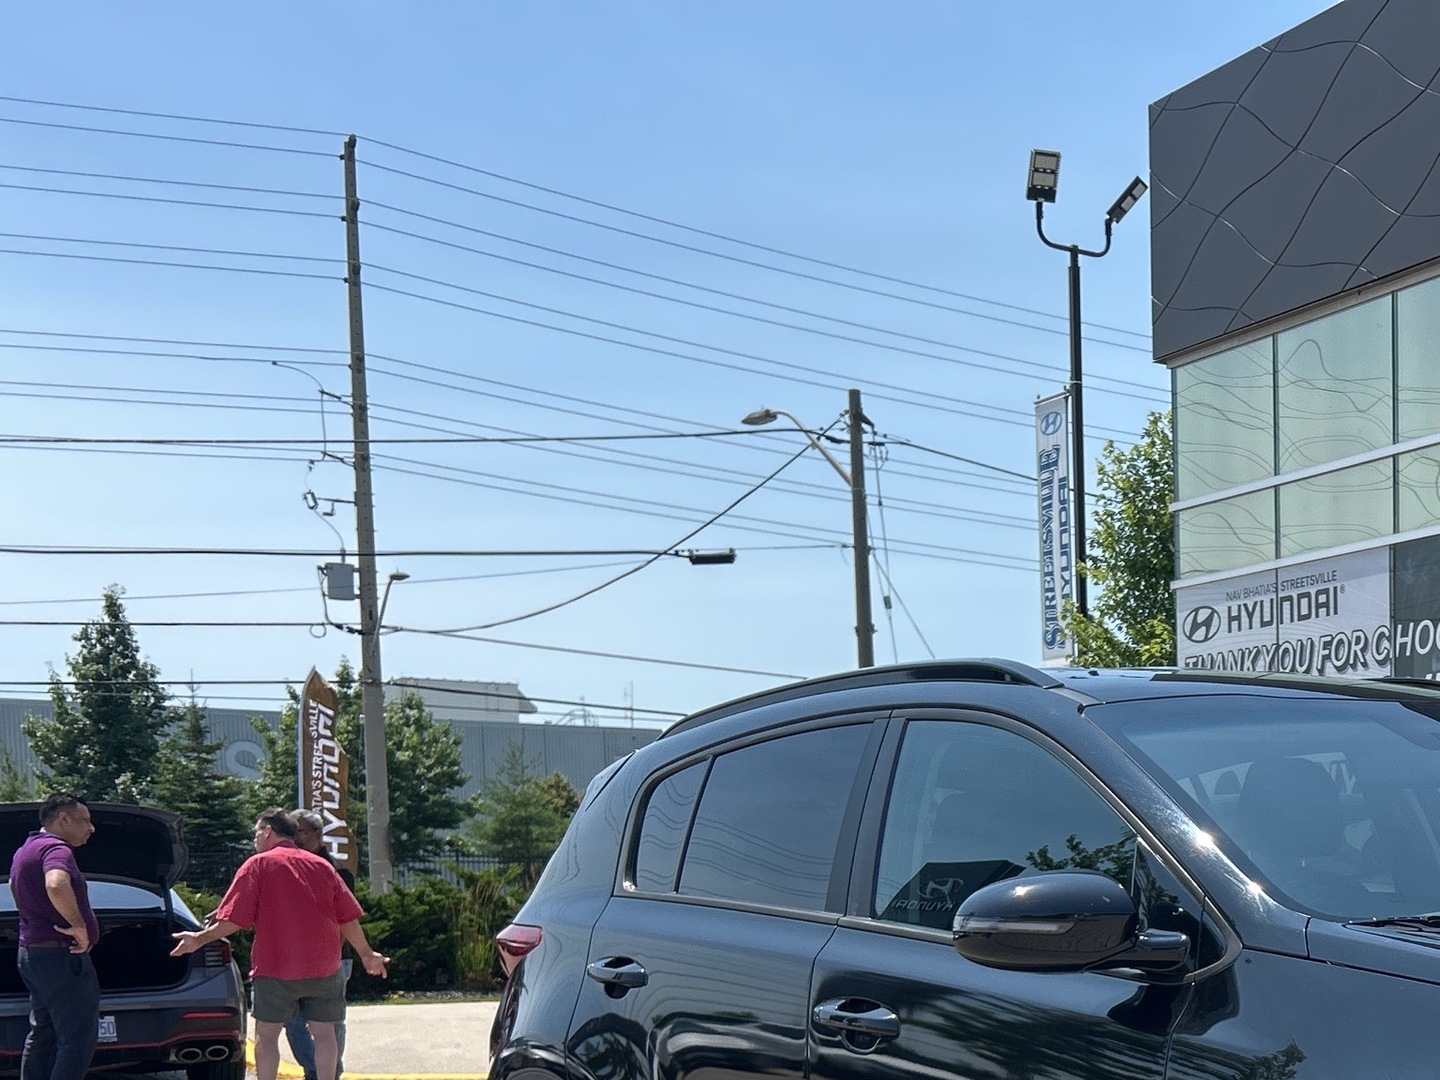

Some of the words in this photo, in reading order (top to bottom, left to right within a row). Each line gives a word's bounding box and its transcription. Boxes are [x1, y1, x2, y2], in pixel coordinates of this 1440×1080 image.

[1040, 445, 1064, 650] STREETSVILLE
[1226, 591, 1242, 602] NAV
[1244, 582, 1278, 599] BHATIA'S
[1280, 570, 1338, 592] STREETSVILLE
[1262, 637, 1312, 673] YOU
[1317, 627, 1368, 672] FOR
[309, 699, 325, 781] STREESVILLE
[311, 781, 323, 815] ATIA'S
[318, 703, 349, 860] HYUNDAI
[100, 1021, 115, 1035] 50
